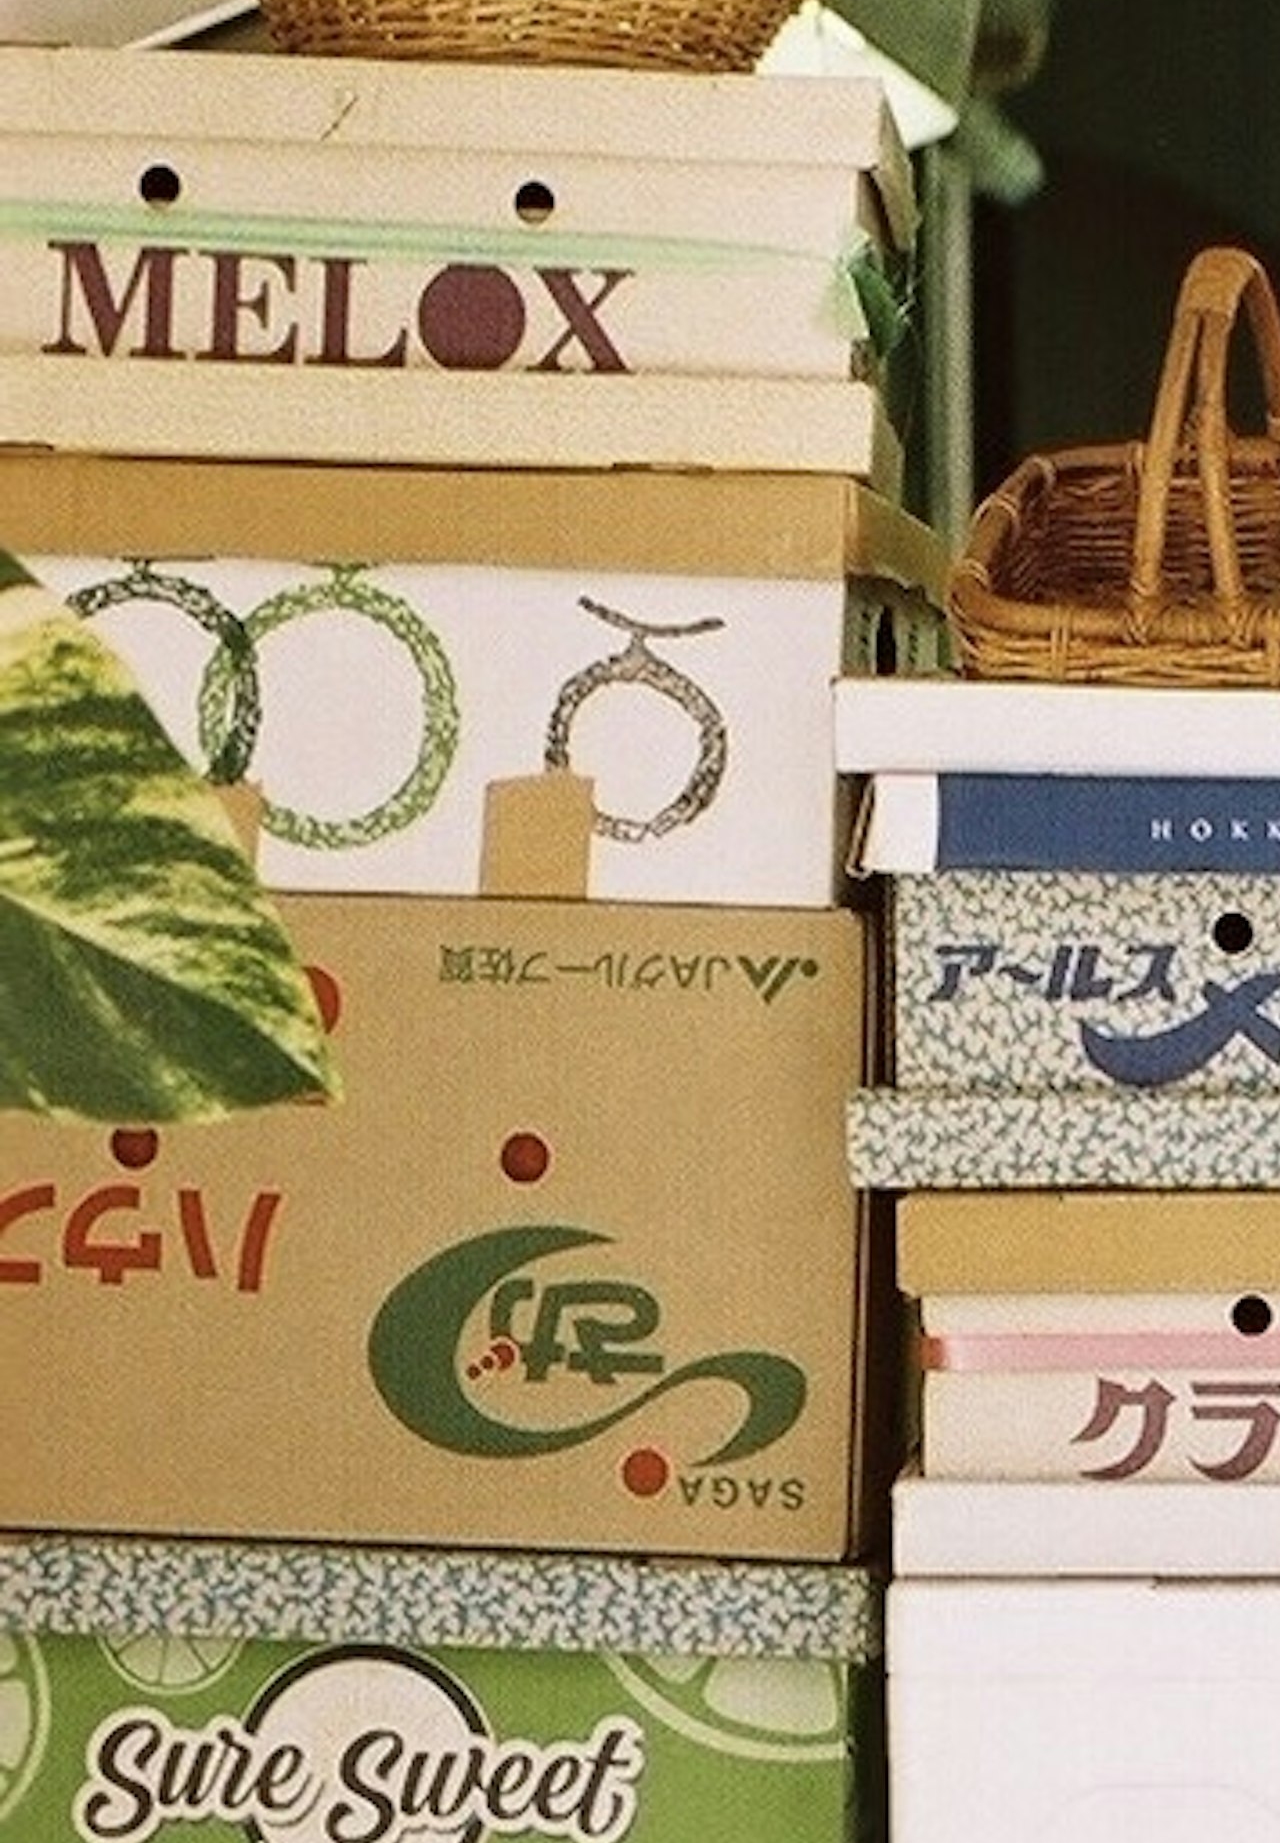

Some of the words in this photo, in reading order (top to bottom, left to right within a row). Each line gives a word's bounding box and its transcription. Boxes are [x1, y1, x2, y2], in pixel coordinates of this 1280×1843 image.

[41, 239, 637, 374] MELOX
[439, 944, 733, 991] JAグループ佐賀
[466, 1277, 666, 1385] さが
[679, 1473, 806, 1512] SAGA
[83, 1717, 316, 1840] Sure
